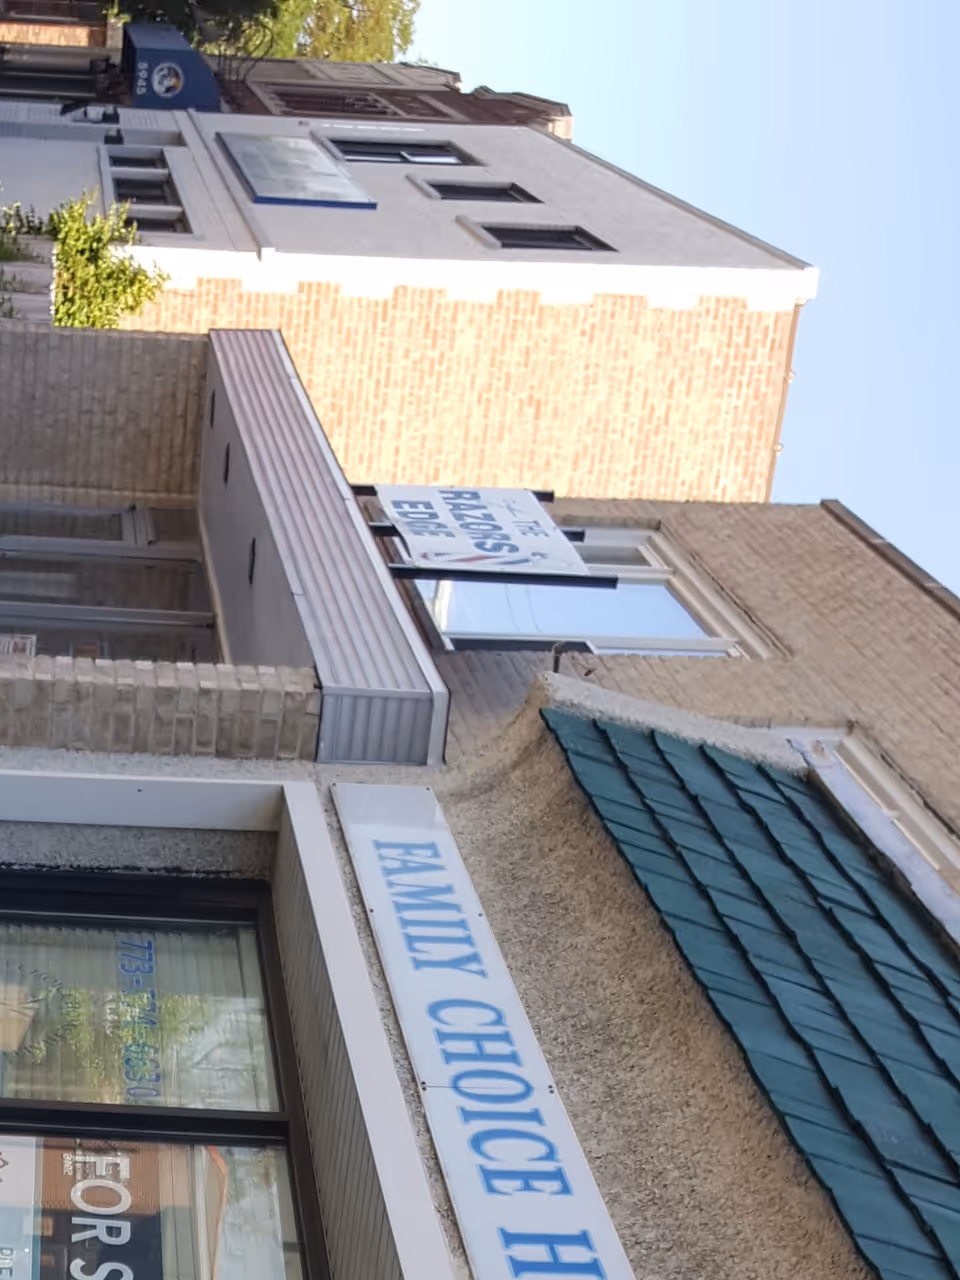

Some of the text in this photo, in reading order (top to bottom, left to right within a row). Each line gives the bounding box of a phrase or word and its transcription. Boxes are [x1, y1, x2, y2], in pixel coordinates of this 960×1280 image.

[390, 500, 456, 538] EDGE
[438, 490, 518, 553] RAZORS
[512, 520, 548, 537] THE
[372, 840, 488, 979] FAMILY
[426, 998, 574, 1198] CHOICE
[70, 1156, 132, 1246] FOR
